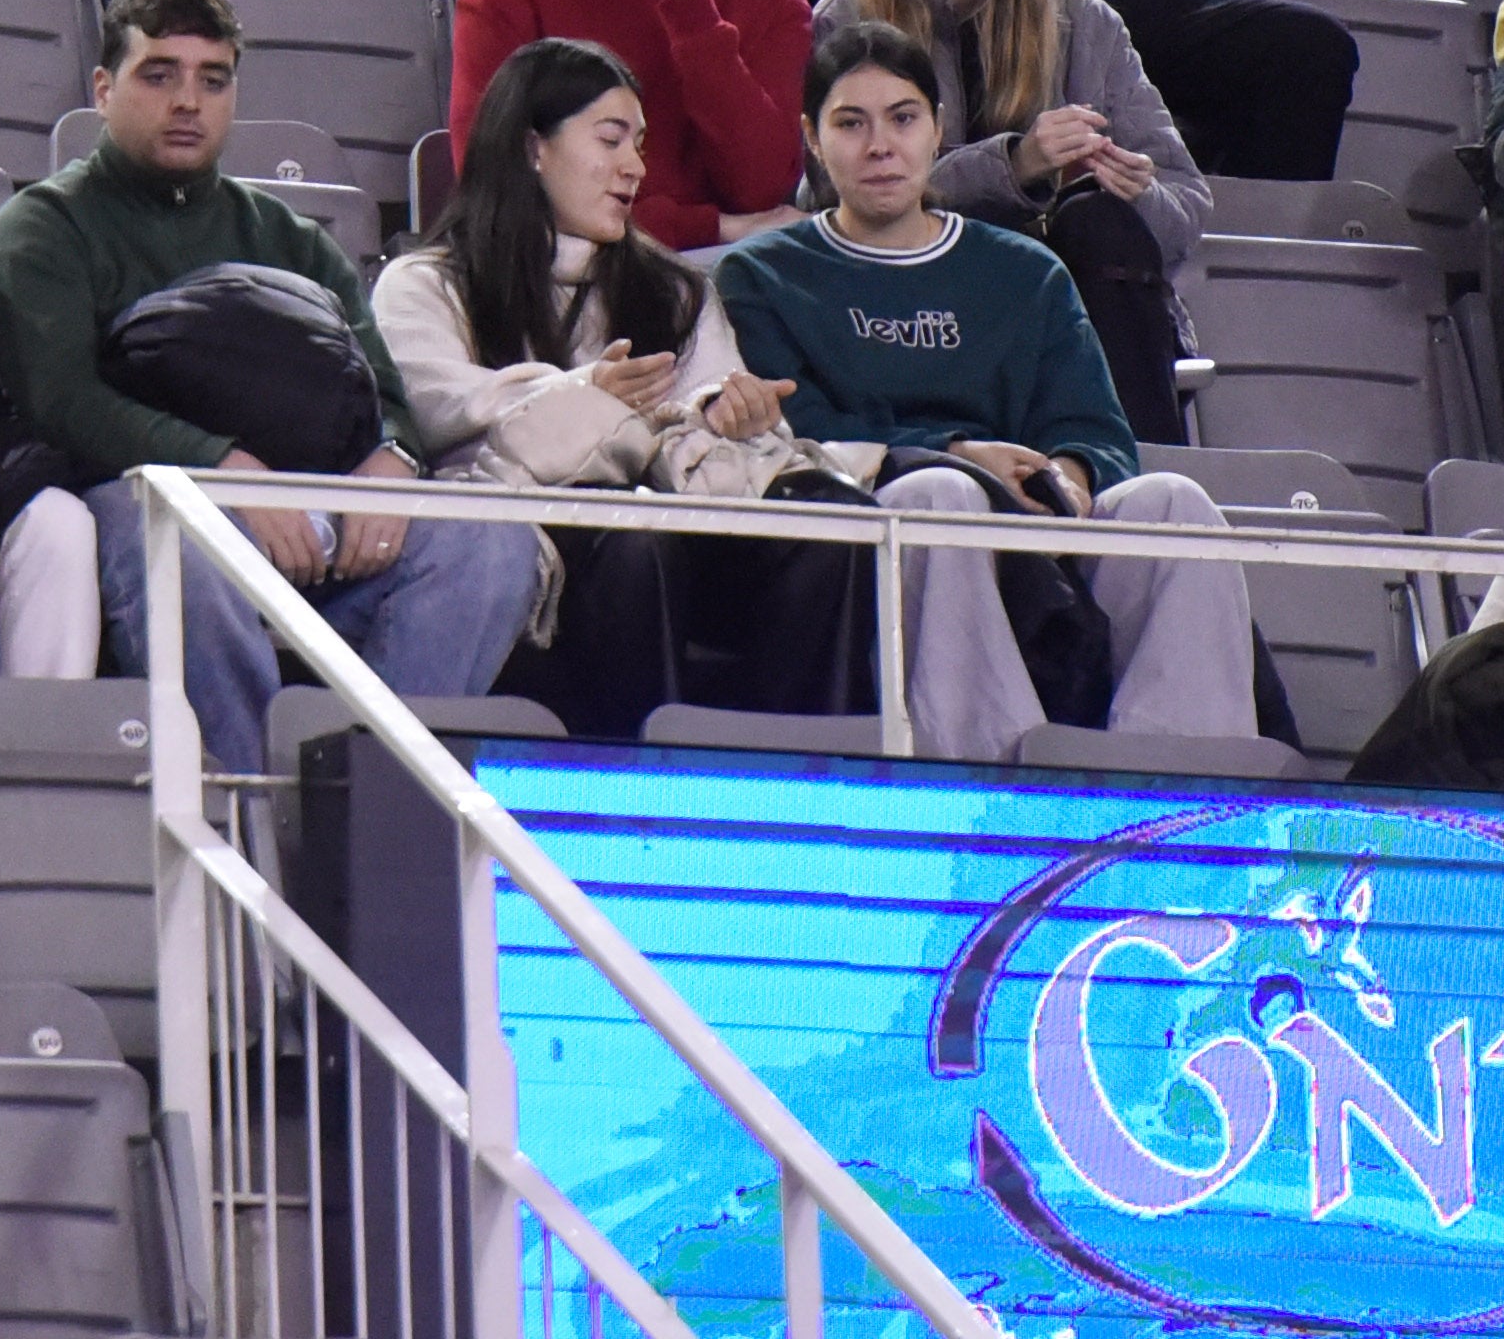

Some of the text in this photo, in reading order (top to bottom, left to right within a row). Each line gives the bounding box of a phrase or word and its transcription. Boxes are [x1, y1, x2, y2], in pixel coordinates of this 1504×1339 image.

[282, 168, 299, 178] 72
[1348, 227, 1365, 238] 78
[849, 308, 960, 348] levi's
[1296, 498, 1313, 509] 76
